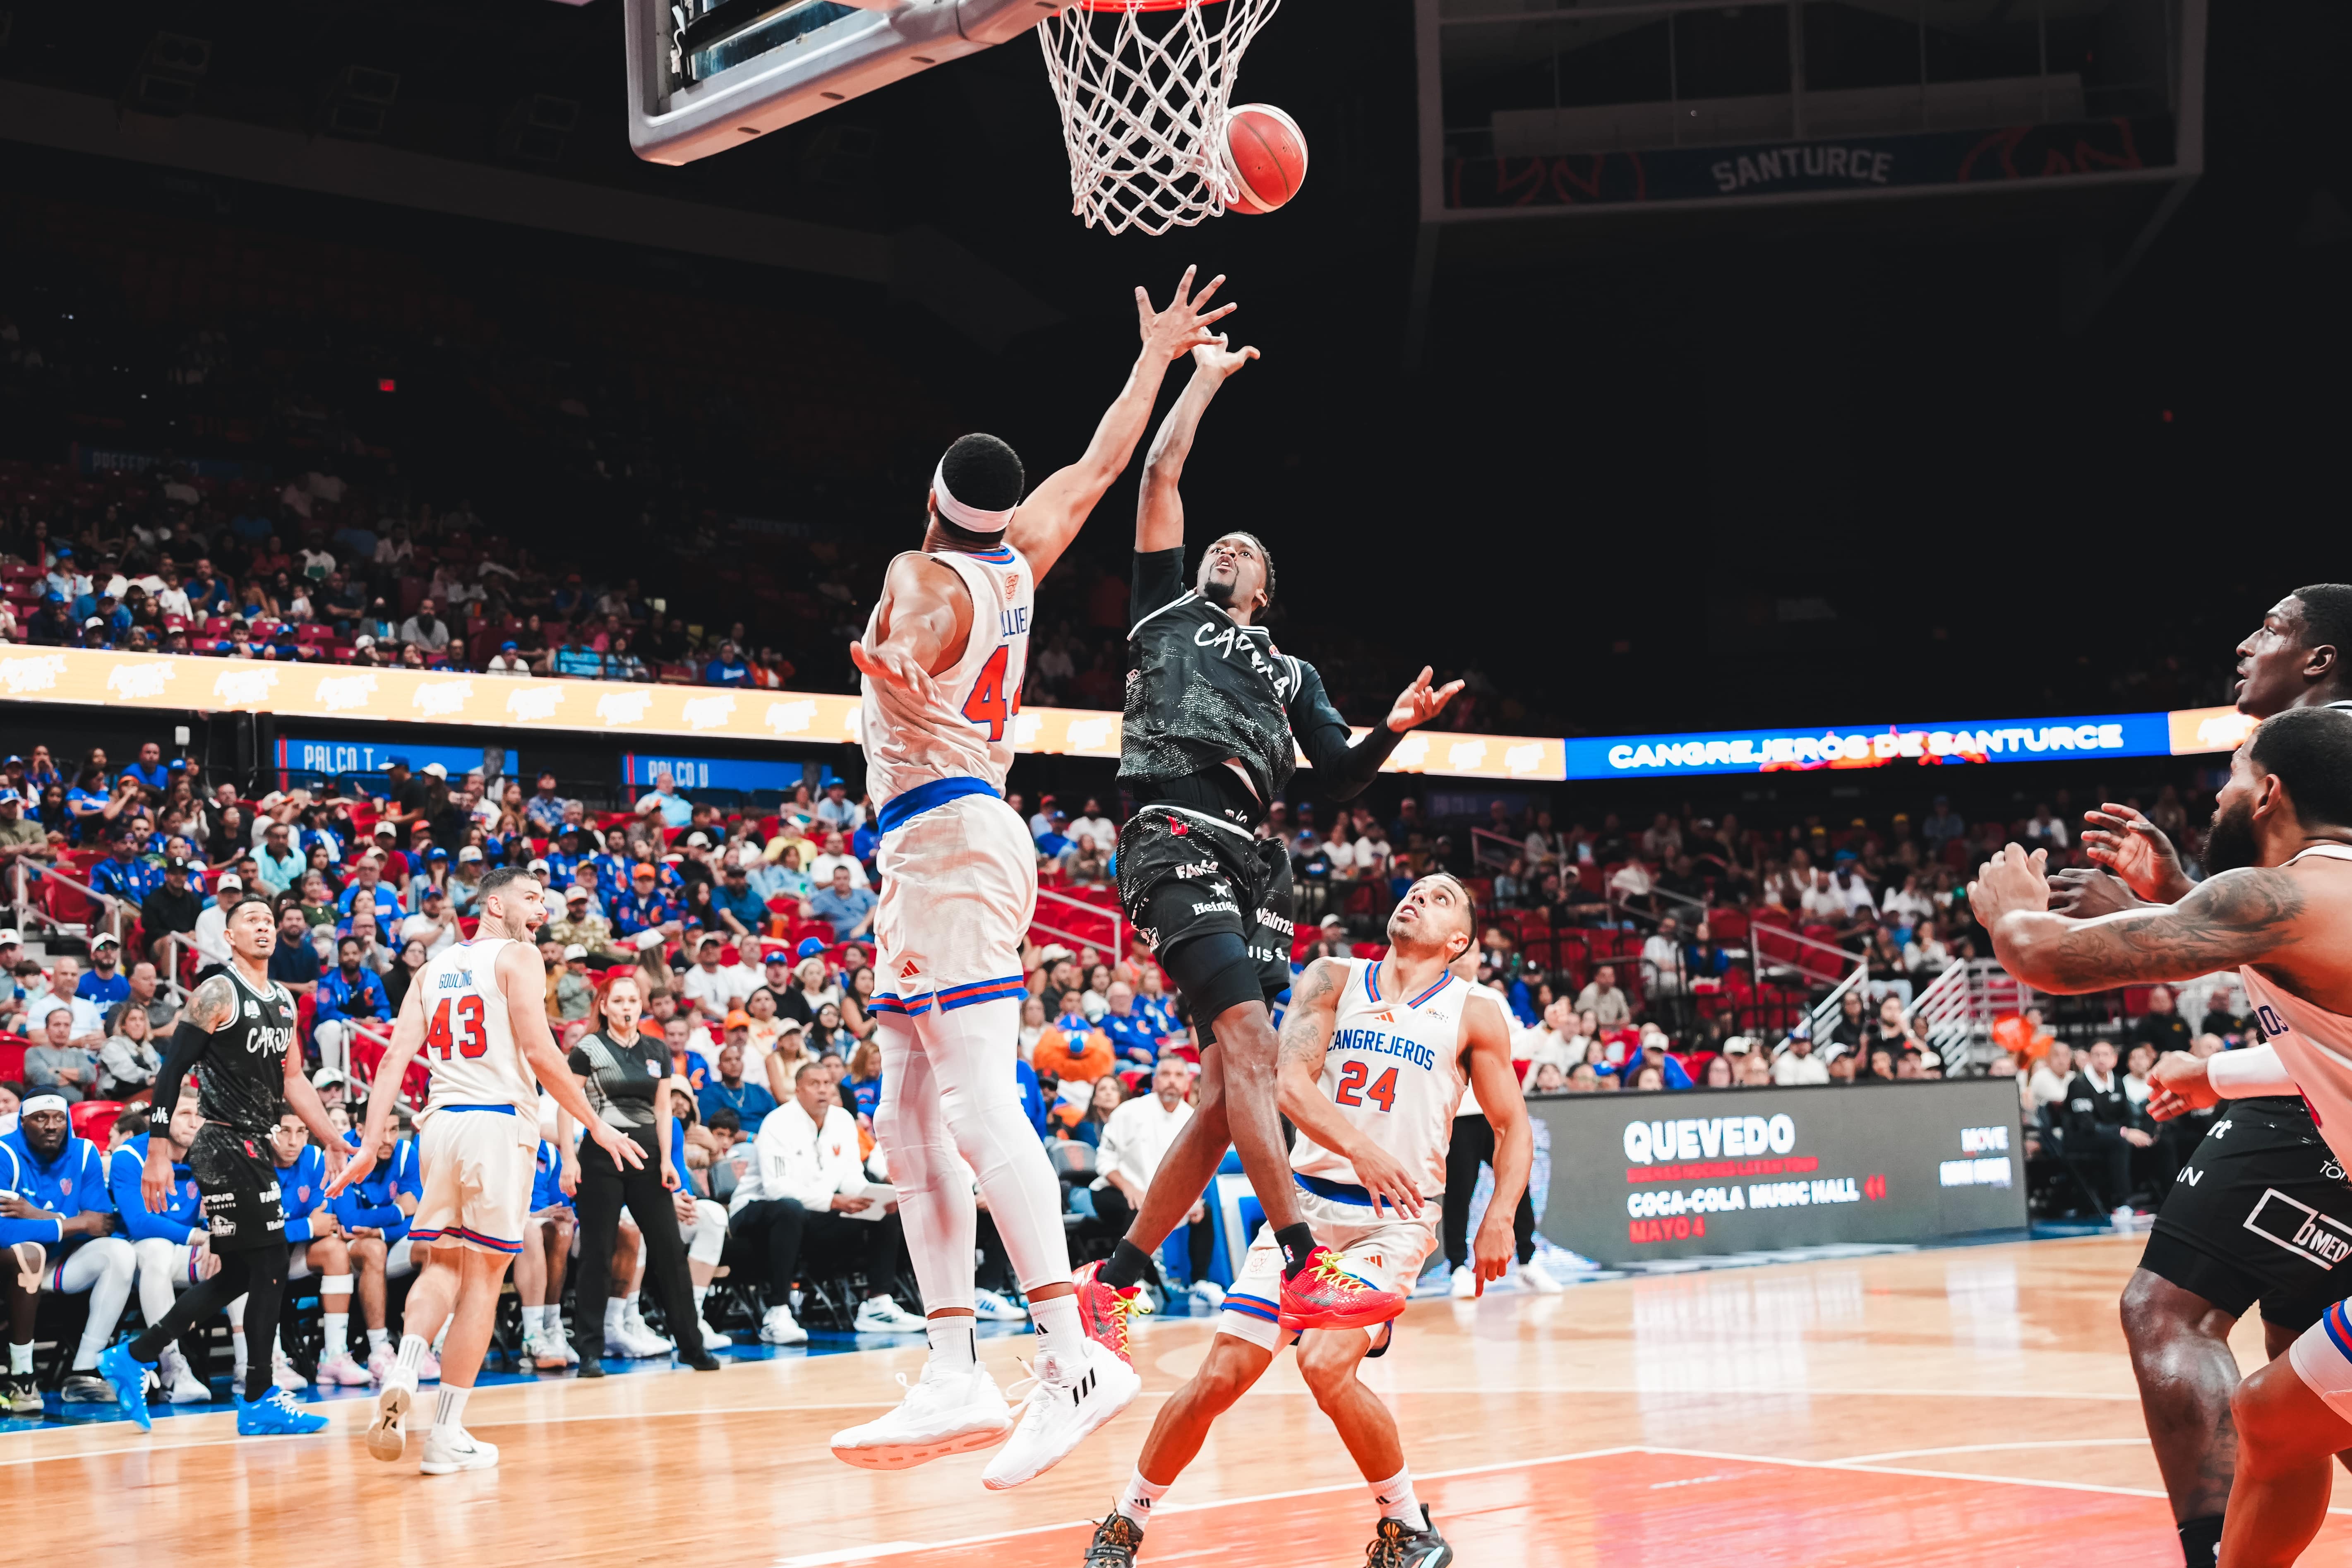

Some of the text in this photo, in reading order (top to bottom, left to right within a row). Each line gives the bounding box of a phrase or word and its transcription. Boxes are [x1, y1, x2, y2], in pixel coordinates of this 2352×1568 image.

[1710, 146, 1894, 192] SANTURCE
[1000, 606, 1028, 638] LLIE
[960, 635, 1030, 742] 4
[304, 744, 374, 772] PALCO T
[1608, 724, 2124, 769] CANGREJEROS DE SANTURCE
[427, 994, 487, 1060] 43
[1335, 1060, 1399, 1112] 24
[1623, 1113, 1795, 1165] QUEVEDO
[1627, 1177, 1861, 1218] COCA-COLA MUSIC HALL
[1629, 1215, 1705, 1243] MAYO 4
